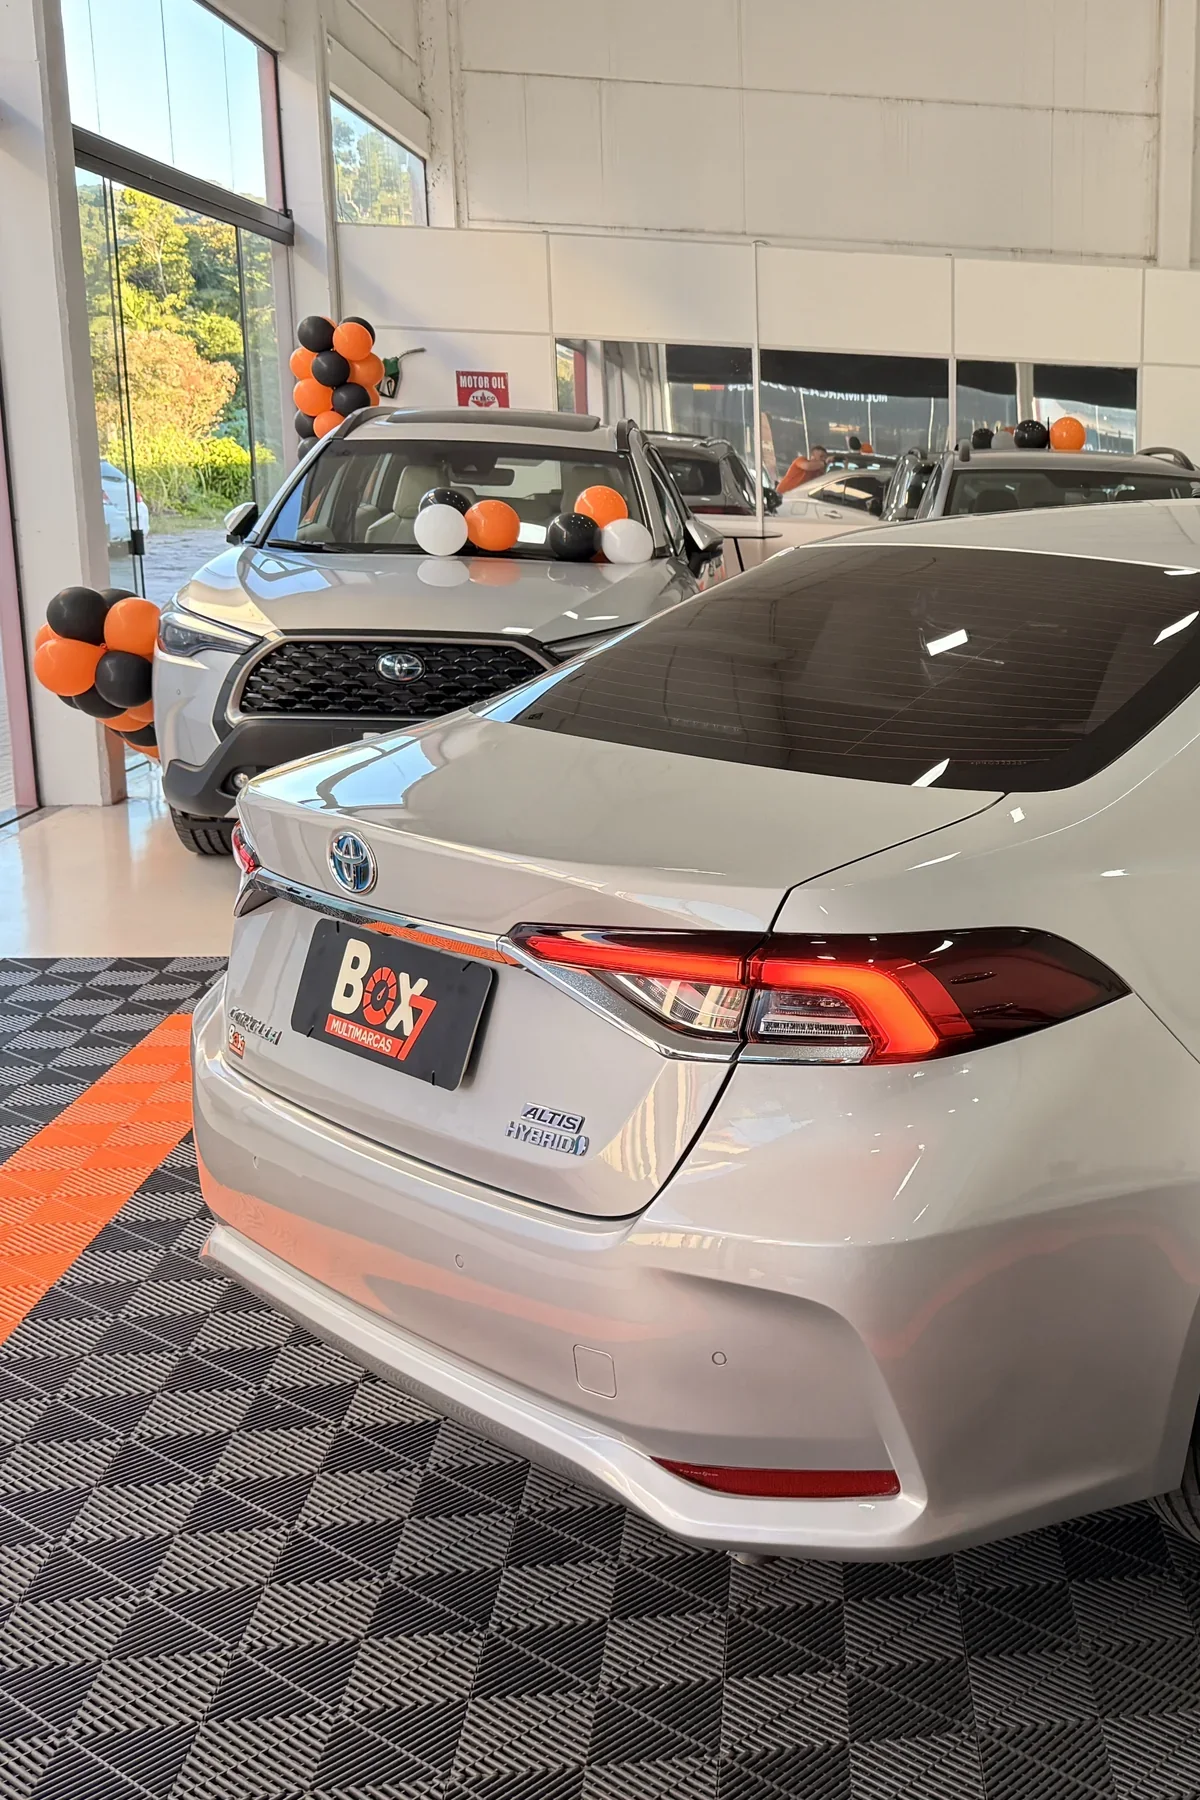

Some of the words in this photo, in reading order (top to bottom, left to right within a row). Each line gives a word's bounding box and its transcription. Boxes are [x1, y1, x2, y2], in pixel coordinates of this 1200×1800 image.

[460, 375, 489, 389] MOTOR
[491, 376, 506, 389] OIL
[330, 1018, 393, 1053] MULTIMARCAS
[522, 1107, 579, 1131] ALTIS
[505, 1120, 577, 1155] HYBRID
